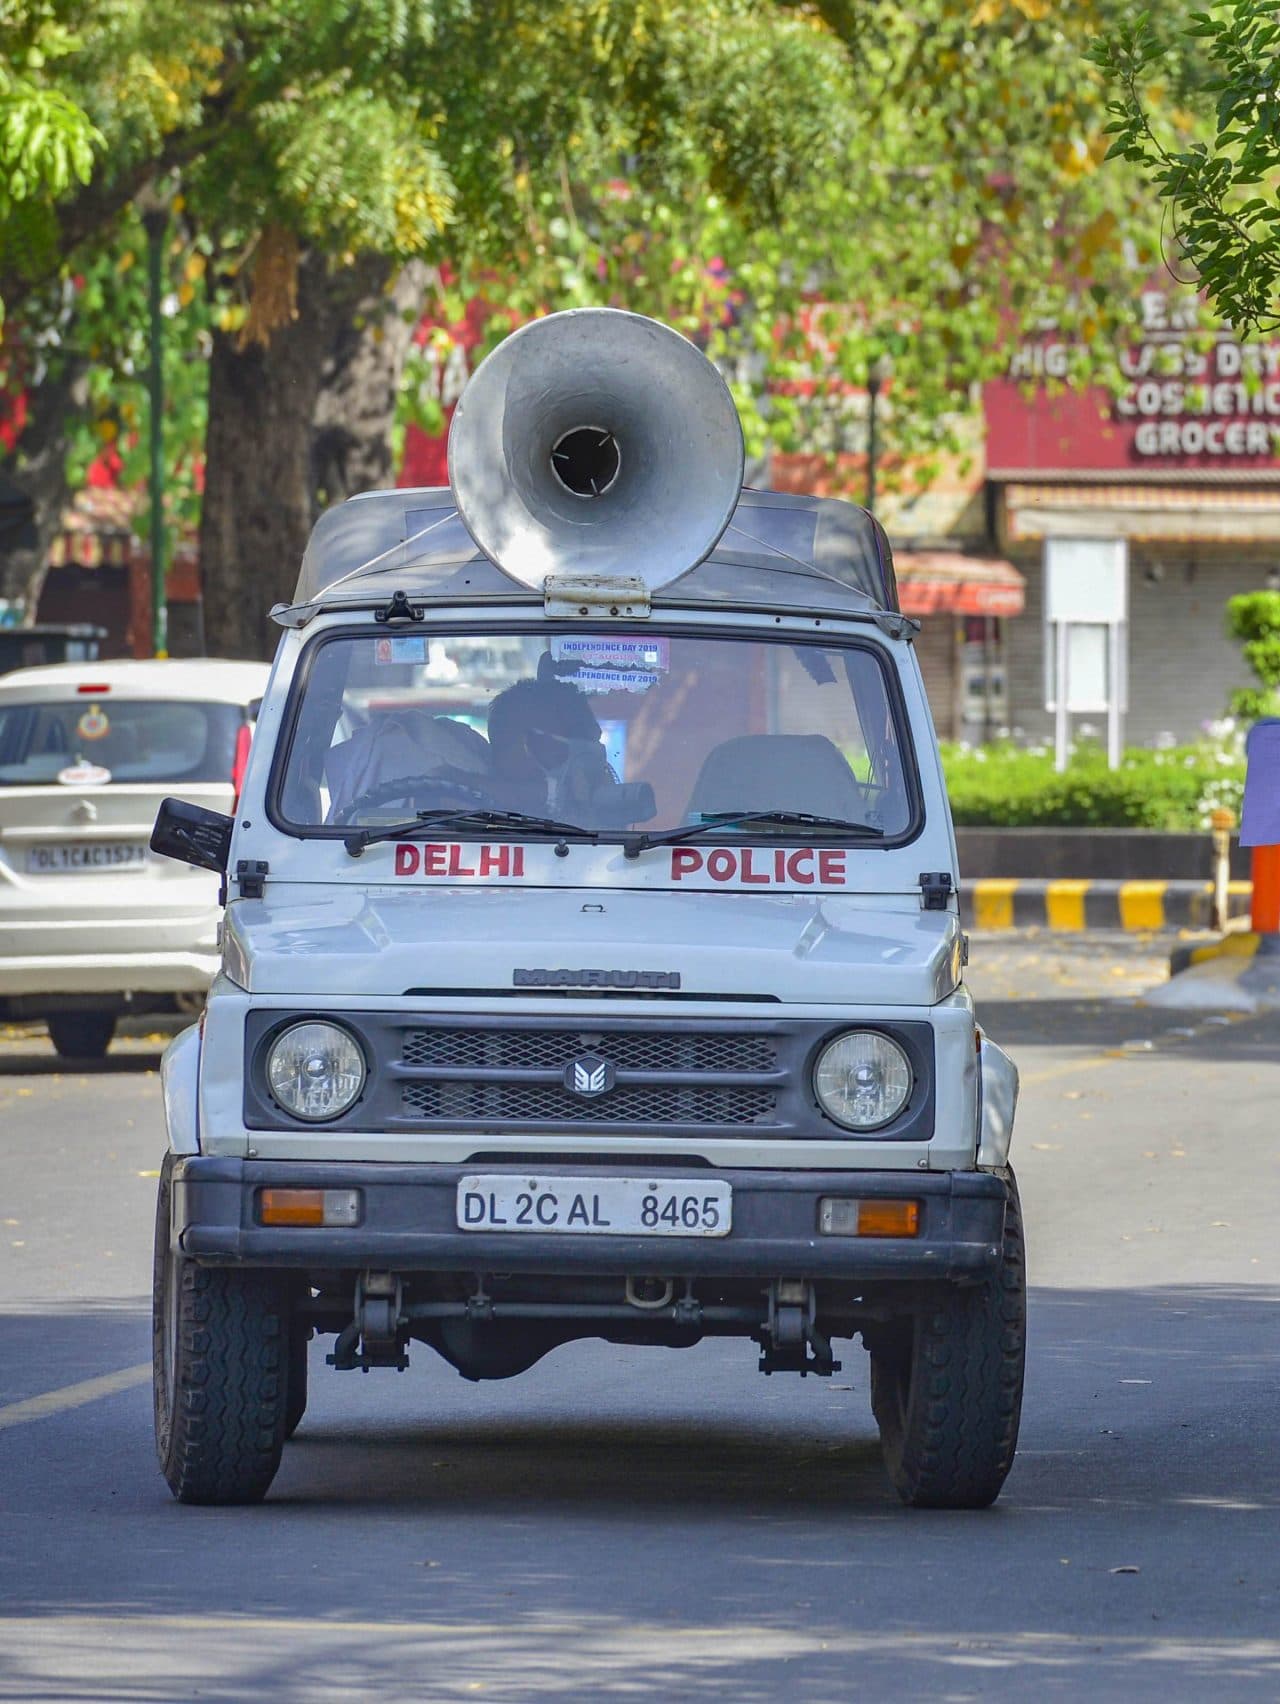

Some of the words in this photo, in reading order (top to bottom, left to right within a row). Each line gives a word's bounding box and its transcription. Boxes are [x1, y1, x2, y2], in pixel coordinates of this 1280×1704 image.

[563, 643, 620, 652] INDEPENDENCE
[622, 644, 637, 652] DAY
[622, 674, 637, 682] DAY
[638, 675, 658, 683] 2019
[395, 843, 525, 877] DELHI
[670, 847, 847, 885] POLICE
[512, 968, 681, 990] MARUTI
[640, 1195, 720, 1229] 8465
